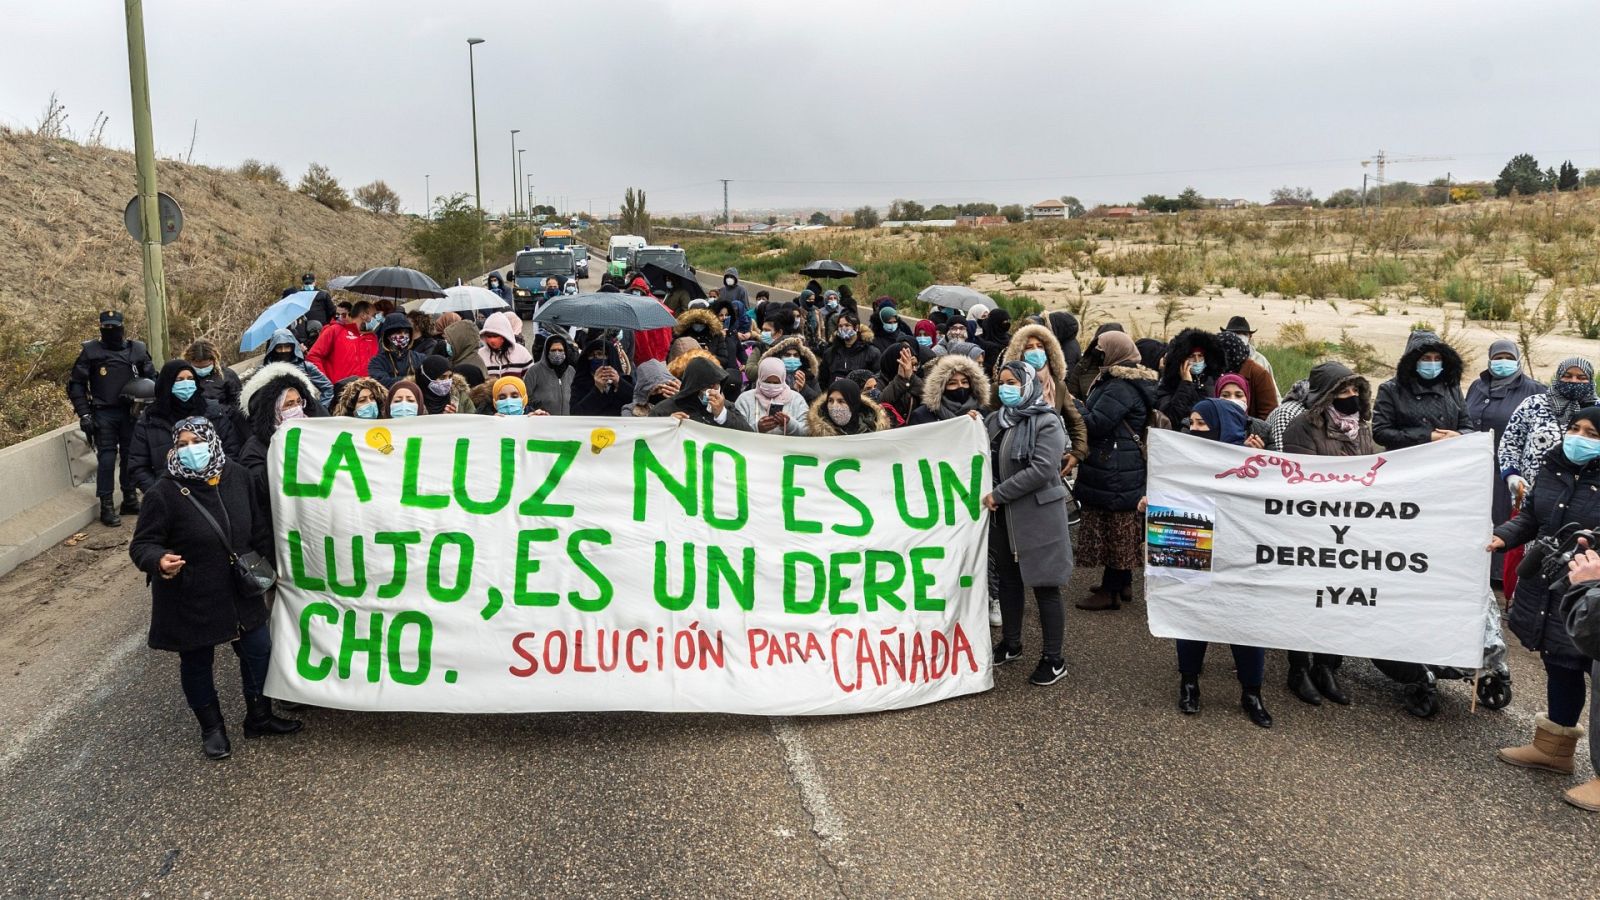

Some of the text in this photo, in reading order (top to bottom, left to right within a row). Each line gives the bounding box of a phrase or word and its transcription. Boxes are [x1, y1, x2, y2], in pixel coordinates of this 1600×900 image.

[283, 427, 984, 536] LA LUZ NO ES UN
[1265, 498, 1420, 520] DIGNIDAD
[1256, 544, 1428, 573] DERECHOS
[1330, 525, 1351, 544] Y
[288, 528, 974, 621] LUJO, ES UN DERE-
[1315, 586, 1378, 608] ¡YA!
[296, 602, 458, 685] CHO.
[748, 628, 826, 669] PARA
[831, 622, 978, 693] CAÑADA
